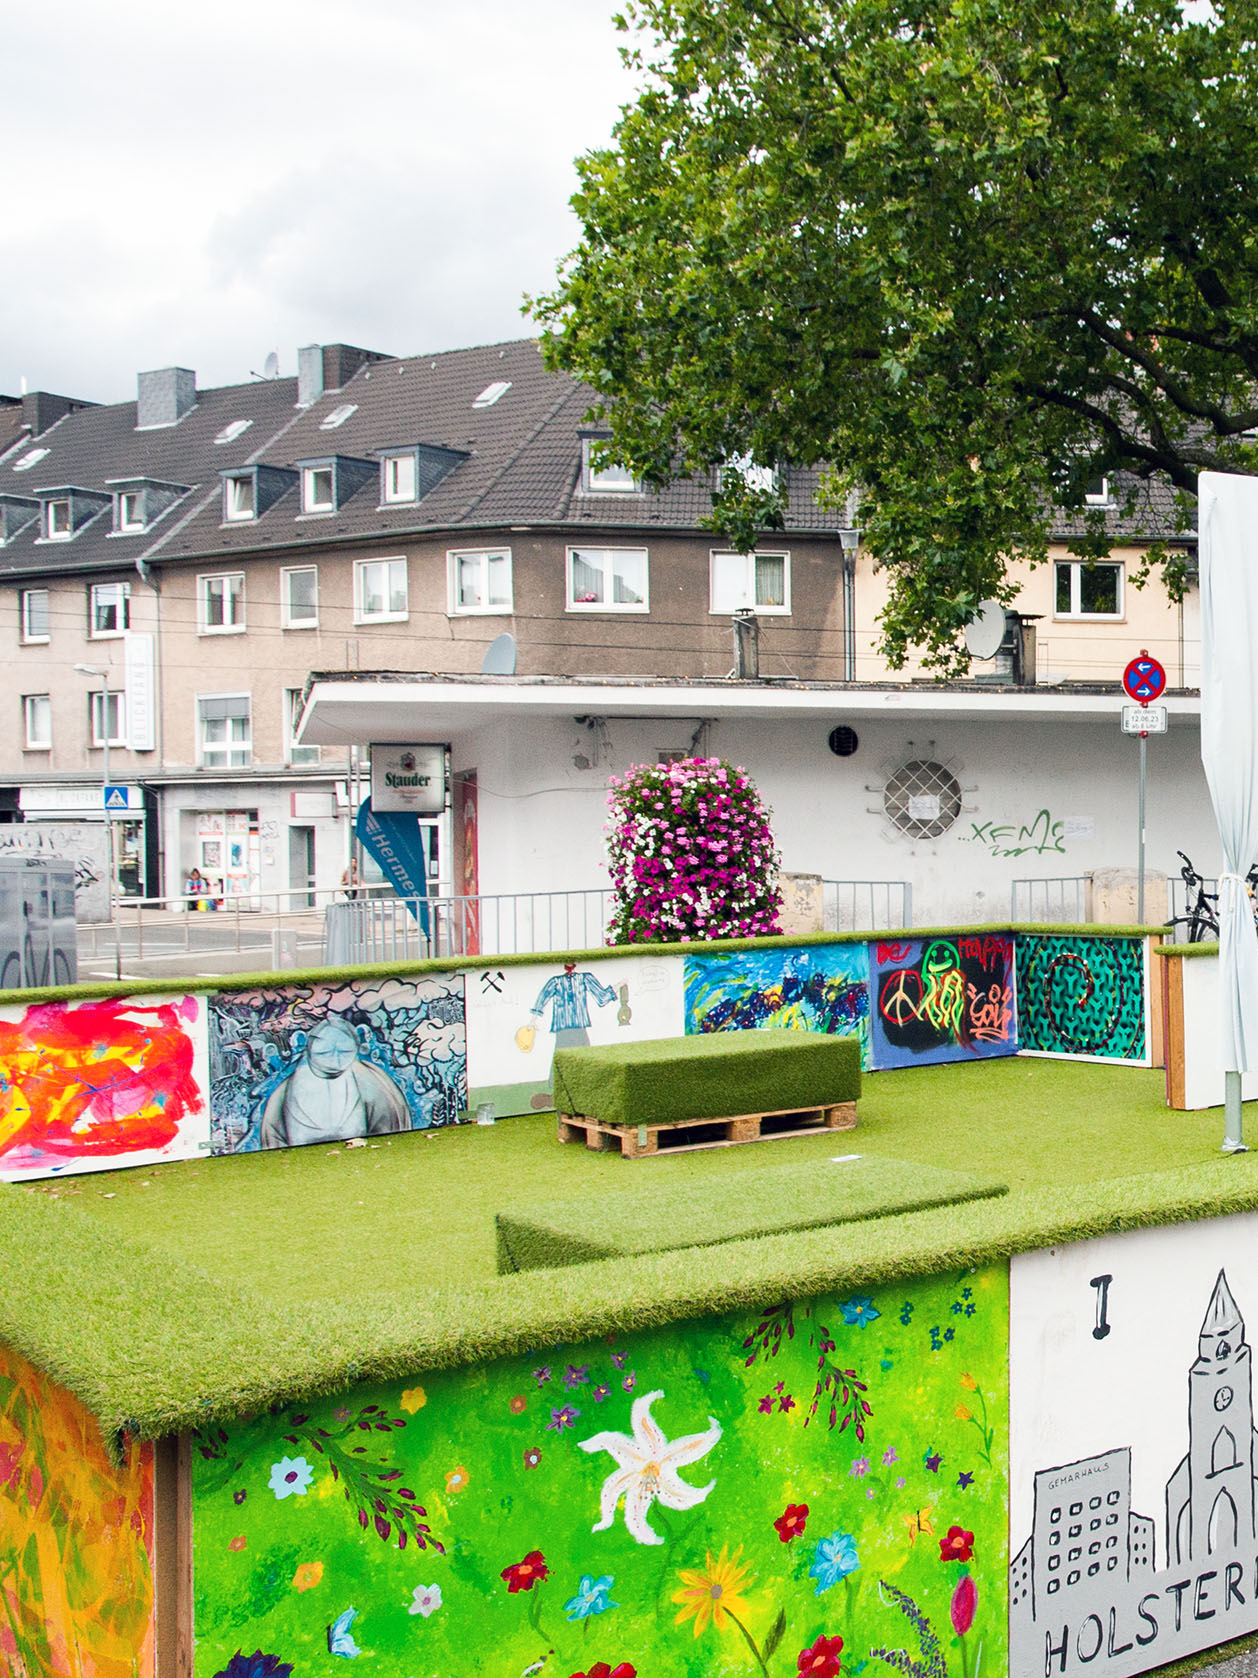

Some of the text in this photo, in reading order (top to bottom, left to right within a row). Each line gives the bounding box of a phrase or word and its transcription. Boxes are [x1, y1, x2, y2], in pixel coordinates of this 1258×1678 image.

[385, 772, 431, 788] Stauder
[372, 833, 422, 899] Hermes
[1090, 1275, 1113, 1339] I
[1048, 1463, 1110, 1490] GEMARHAUS
